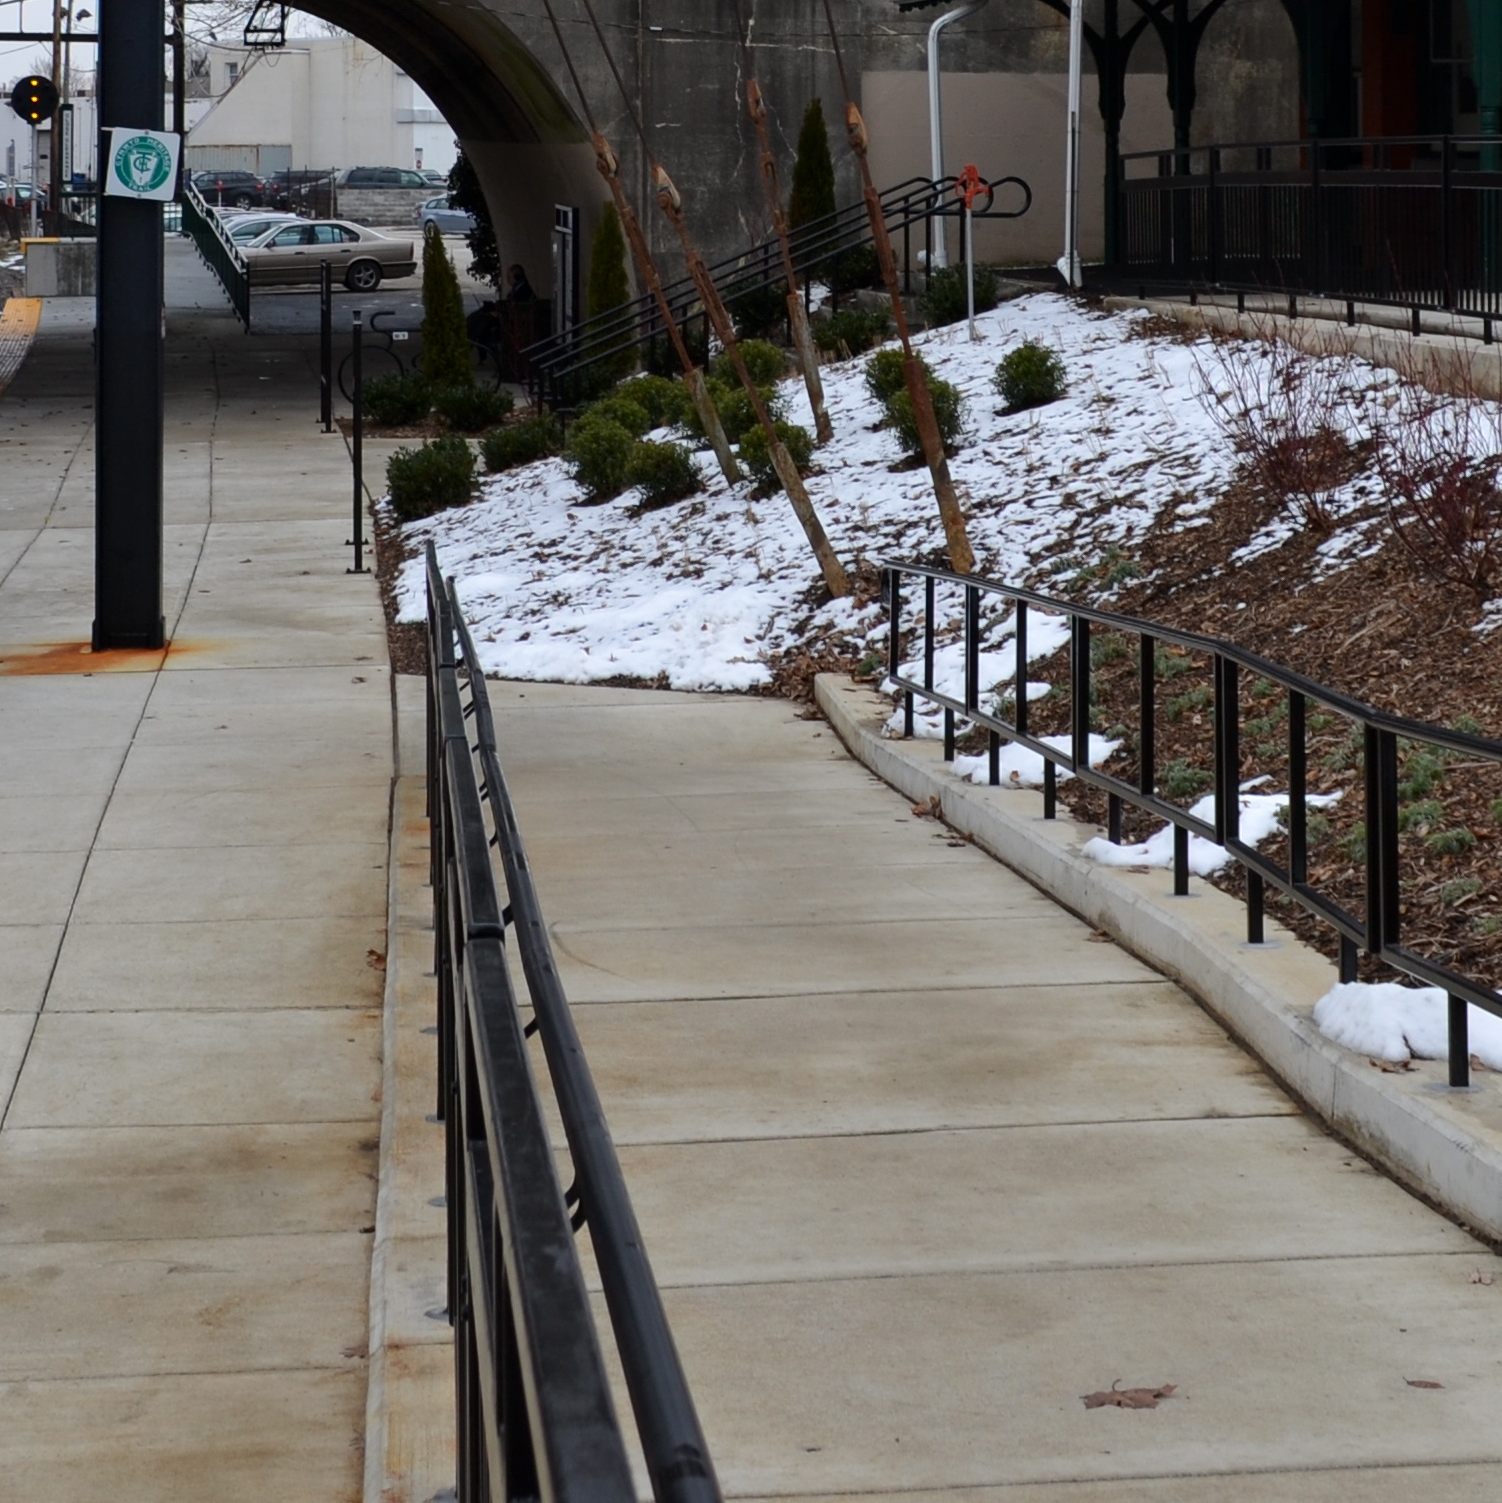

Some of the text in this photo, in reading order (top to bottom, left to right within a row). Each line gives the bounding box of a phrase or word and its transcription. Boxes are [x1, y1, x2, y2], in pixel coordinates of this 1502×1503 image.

[115, 137, 171, 173] CYNWYD HERITAGE
[128, 180, 152, 192] TRAIL
